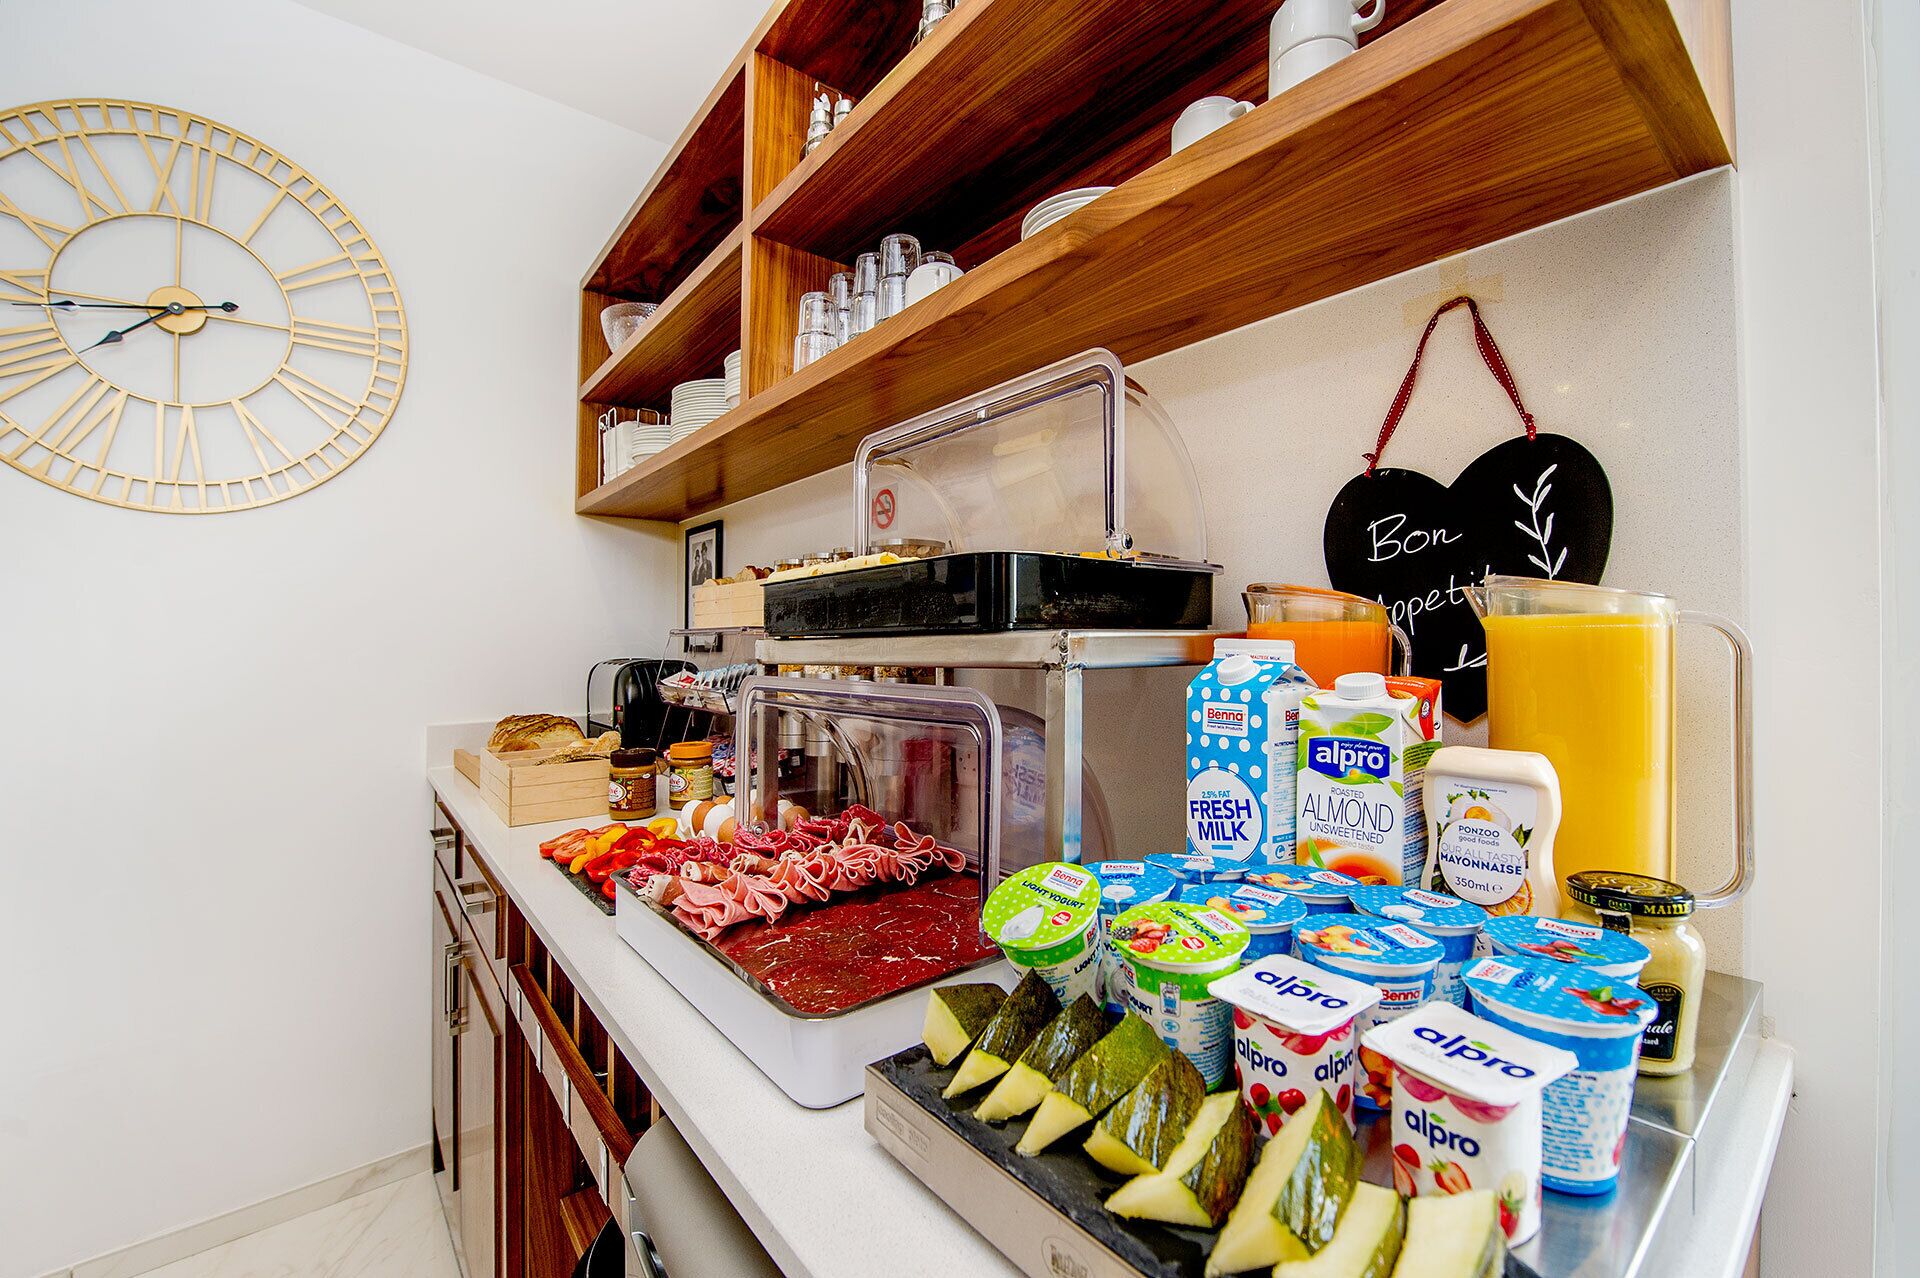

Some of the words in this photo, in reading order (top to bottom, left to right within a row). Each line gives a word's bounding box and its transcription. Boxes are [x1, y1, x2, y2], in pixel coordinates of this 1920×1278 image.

[1367, 513, 1463, 562] Bon
[1207, 708, 1244, 722] Benna
[1285, 710, 1300, 722] Ben
[1315, 740, 1385, 773] alpro
[1202, 790, 1217, 799] 2.5%
[1218, 790, 1231, 798] FAT
[1330, 786, 1365, 800] ROASTED
[1189, 799, 1252, 819] FRESH
[1302, 793, 1394, 833] ALMOND
[1197, 821, 1250, 841] MILK
[1309, 821, 1385, 844] UNSWEETENED
[1458, 825, 1500, 838] PONZOO
[1478, 838, 1500, 847] foods
[1440, 852, 1522, 876] MAYONNAISE
[1441, 842, 1462, 854] OUR
[1464, 847, 1484, 859] ALL
[1487, 851, 1523, 865] TASTY
[1052, 868, 1084, 887] Benna
[1455, 876, 1490, 892] 350ml
[1021, 880, 1050, 897] LIGHT
[1048, 891, 1086, 909] YOGURT
[1254, 971, 1348, 1009] alpro
[1380, 988, 1421, 1001] Benna
[1237, 1037, 1288, 1077] alpro
[1413, 1027, 1536, 1078] alpro
[1405, 1109, 1481, 1158] alpro
